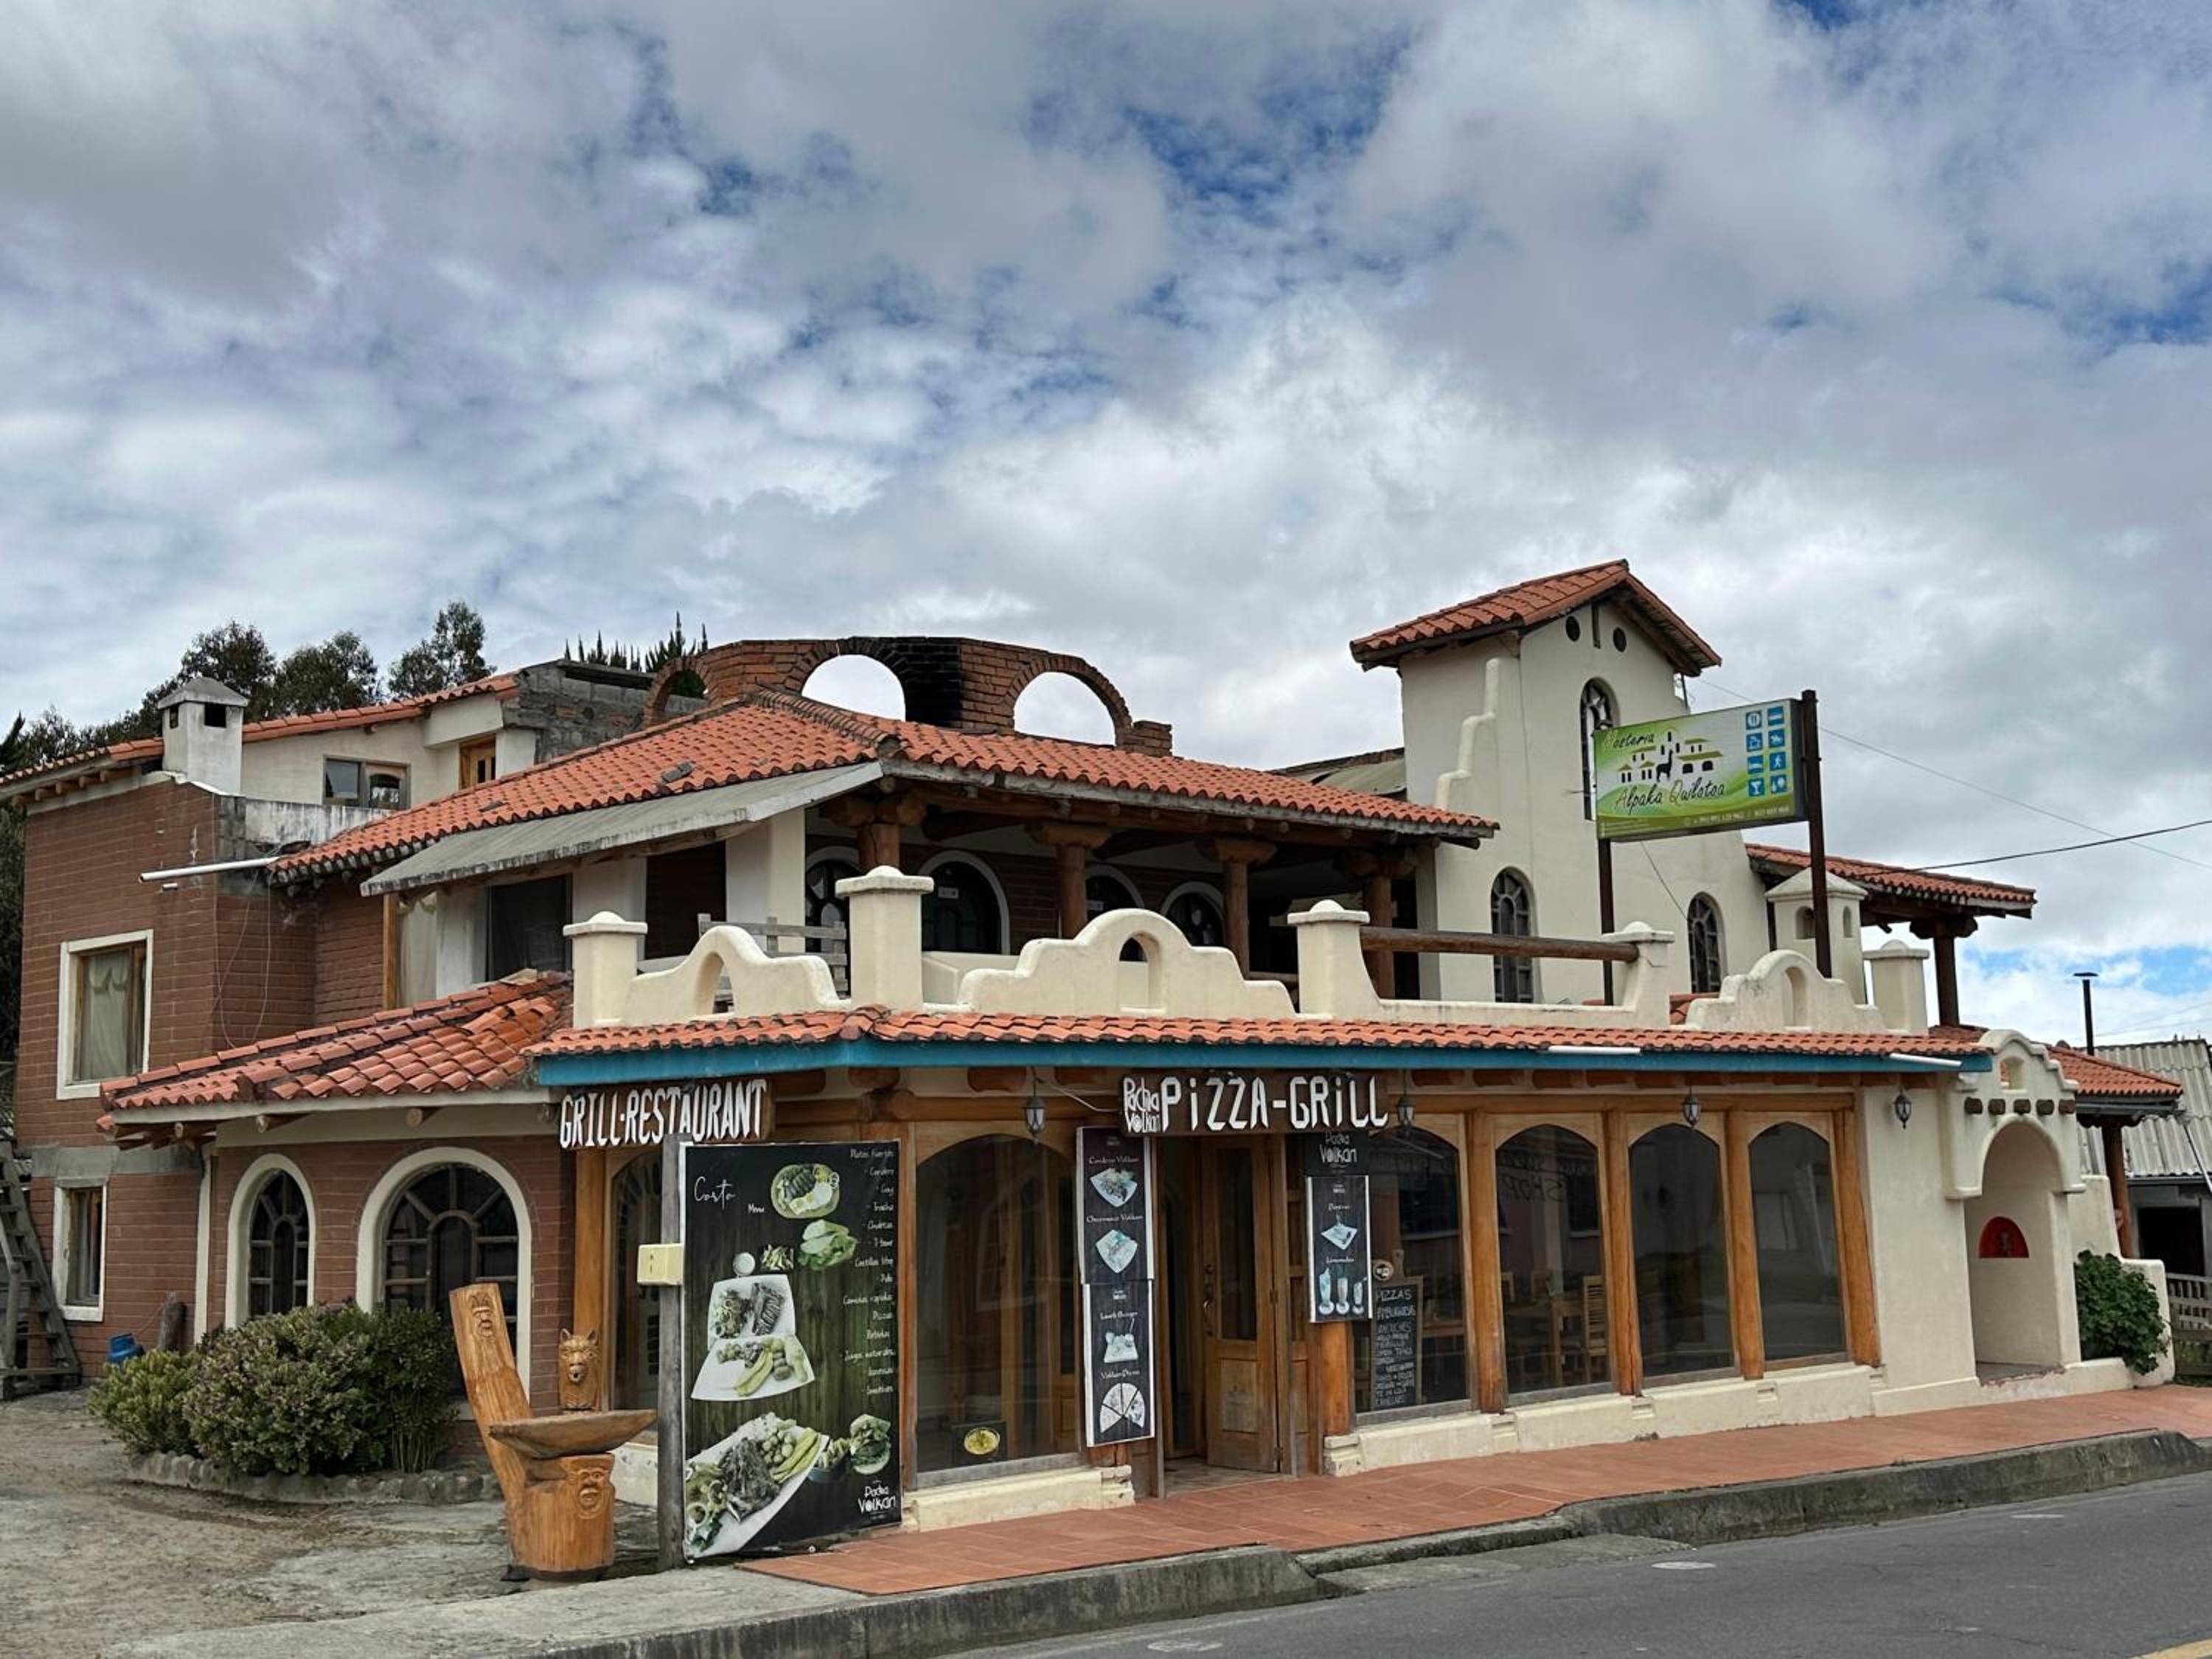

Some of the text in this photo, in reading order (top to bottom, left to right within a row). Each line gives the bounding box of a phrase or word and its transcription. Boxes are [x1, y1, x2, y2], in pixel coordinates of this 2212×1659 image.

[1615, 776, 1725, 815] Alpaka Quilotoa
[1123, 1077, 1160, 1112] Pacha
[1319, 1143, 1357, 1164] Volkan
[858, 1495, 897, 1514] Volkan
